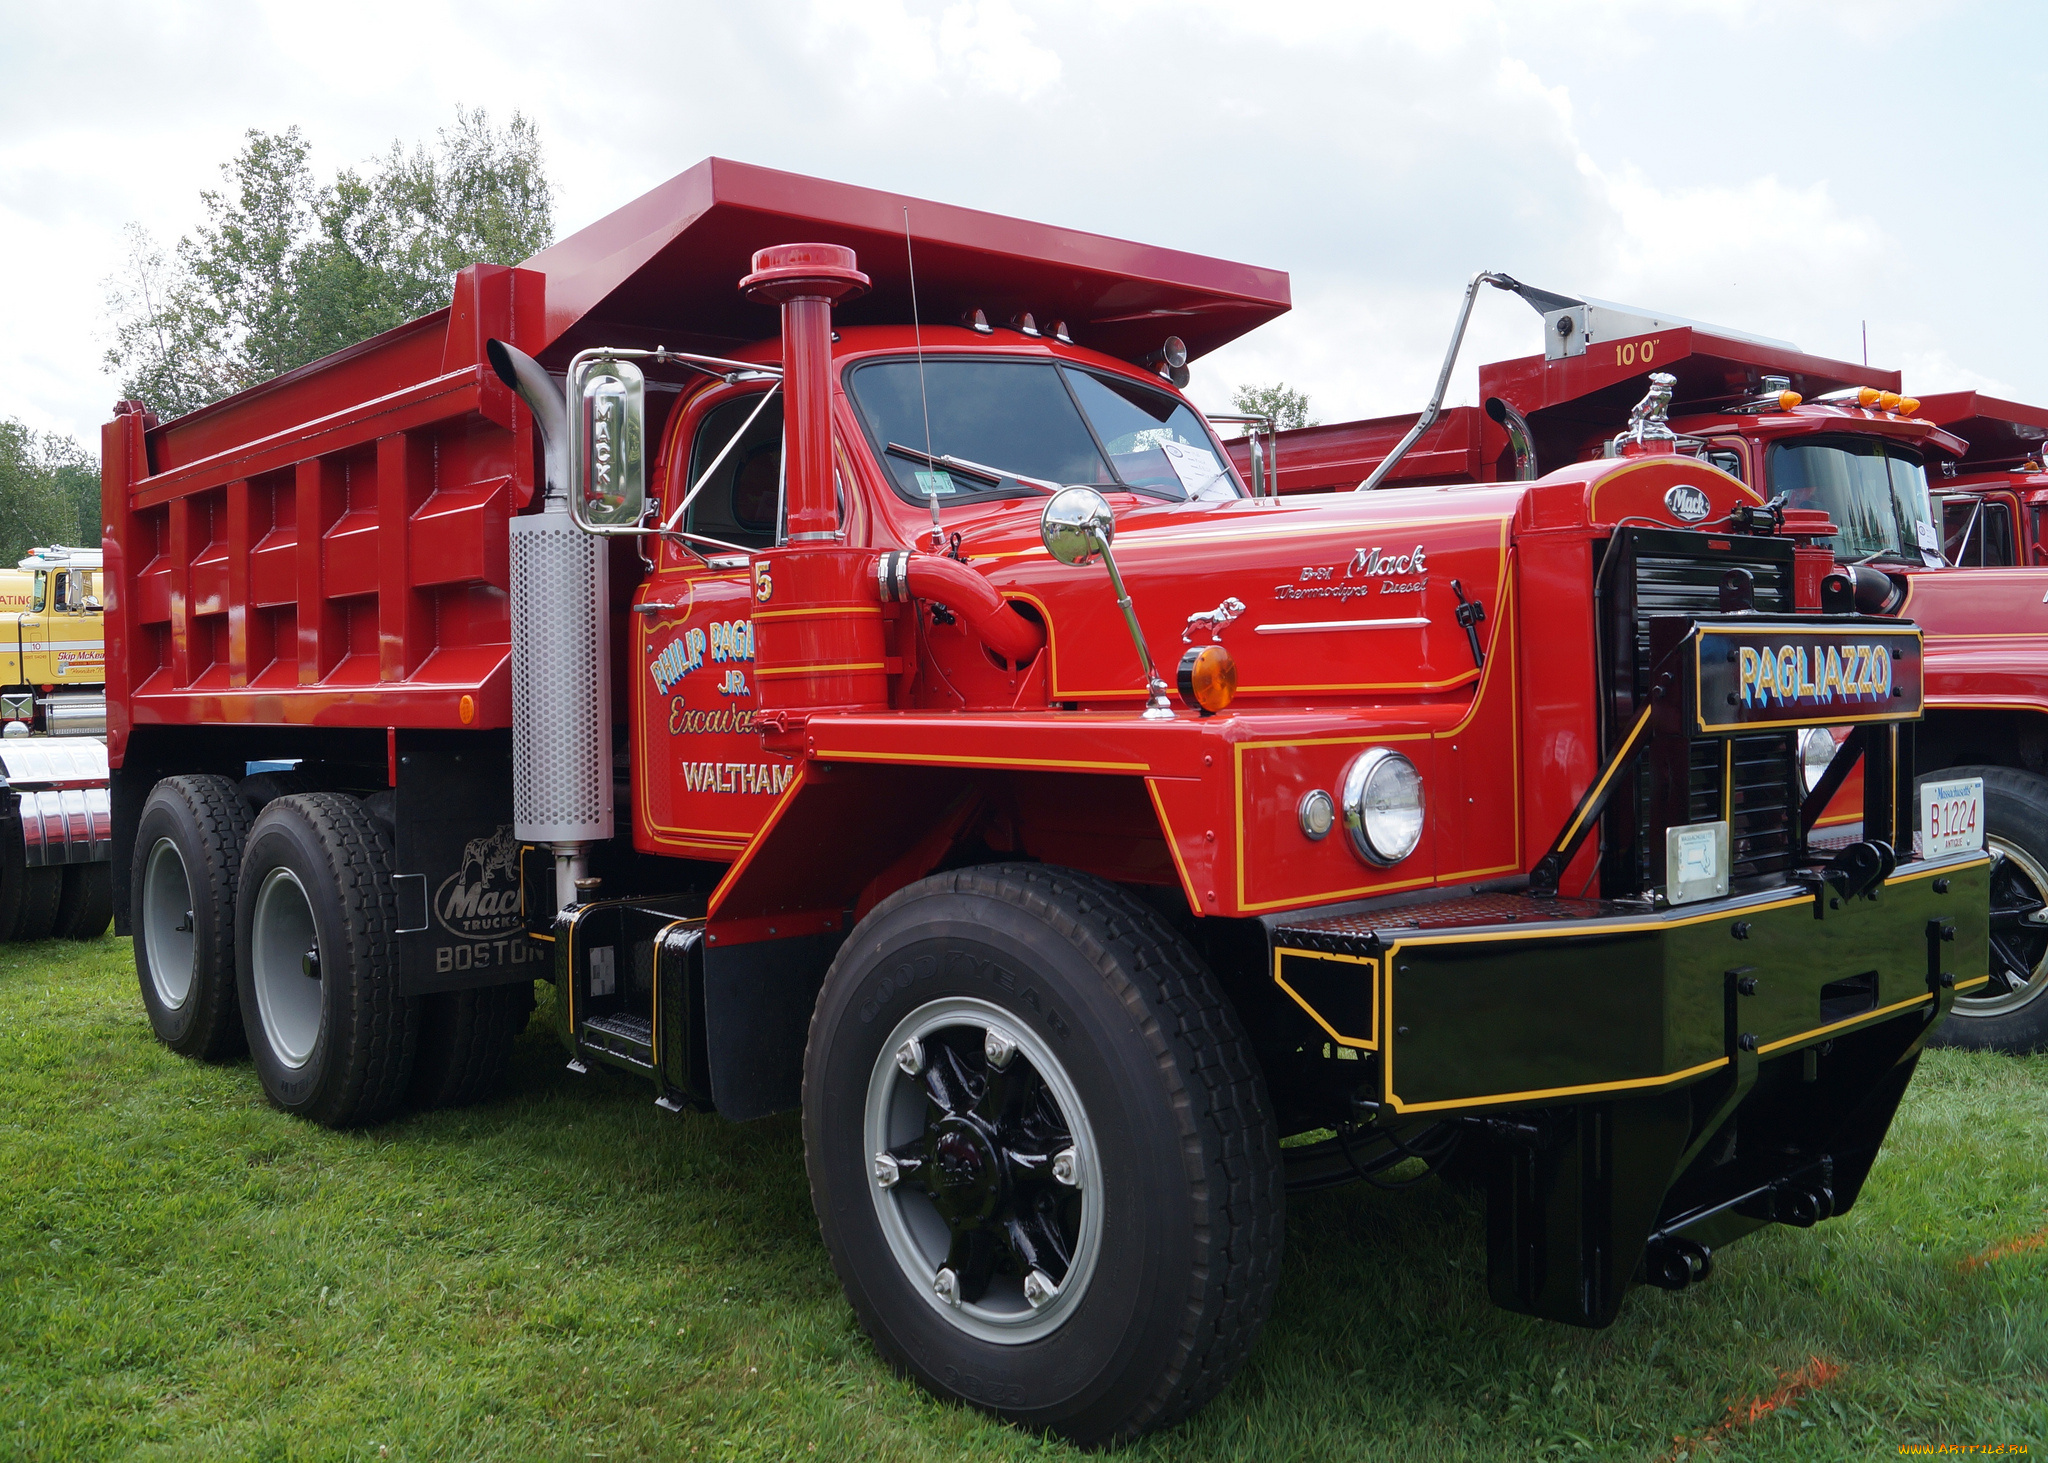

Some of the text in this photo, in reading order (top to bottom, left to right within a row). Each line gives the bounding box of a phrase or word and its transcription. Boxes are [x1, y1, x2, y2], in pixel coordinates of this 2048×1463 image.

[595, 401, 614, 486] MACK
[1672, 488, 1706, 515] Mack
[1343, 544, 1428, 579] Mack
[755, 560, 773, 603] 5
[1275, 577, 1429, 603] Thermodyne Diesel
[32, 642, 41, 651] 10
[57, 651, 76, 662] Skip
[649, 627, 707, 697] PHILIP
[717, 669, 751, 697] JR.
[1739, 644, 1893, 709] PAGLIAZZO
[682, 761, 795, 796] WALTHAM
[1944, 837, 1963, 849] ANTIQUE
[462, 916, 520, 931] TRUCKS
[436, 939, 546, 973] BOSTON
